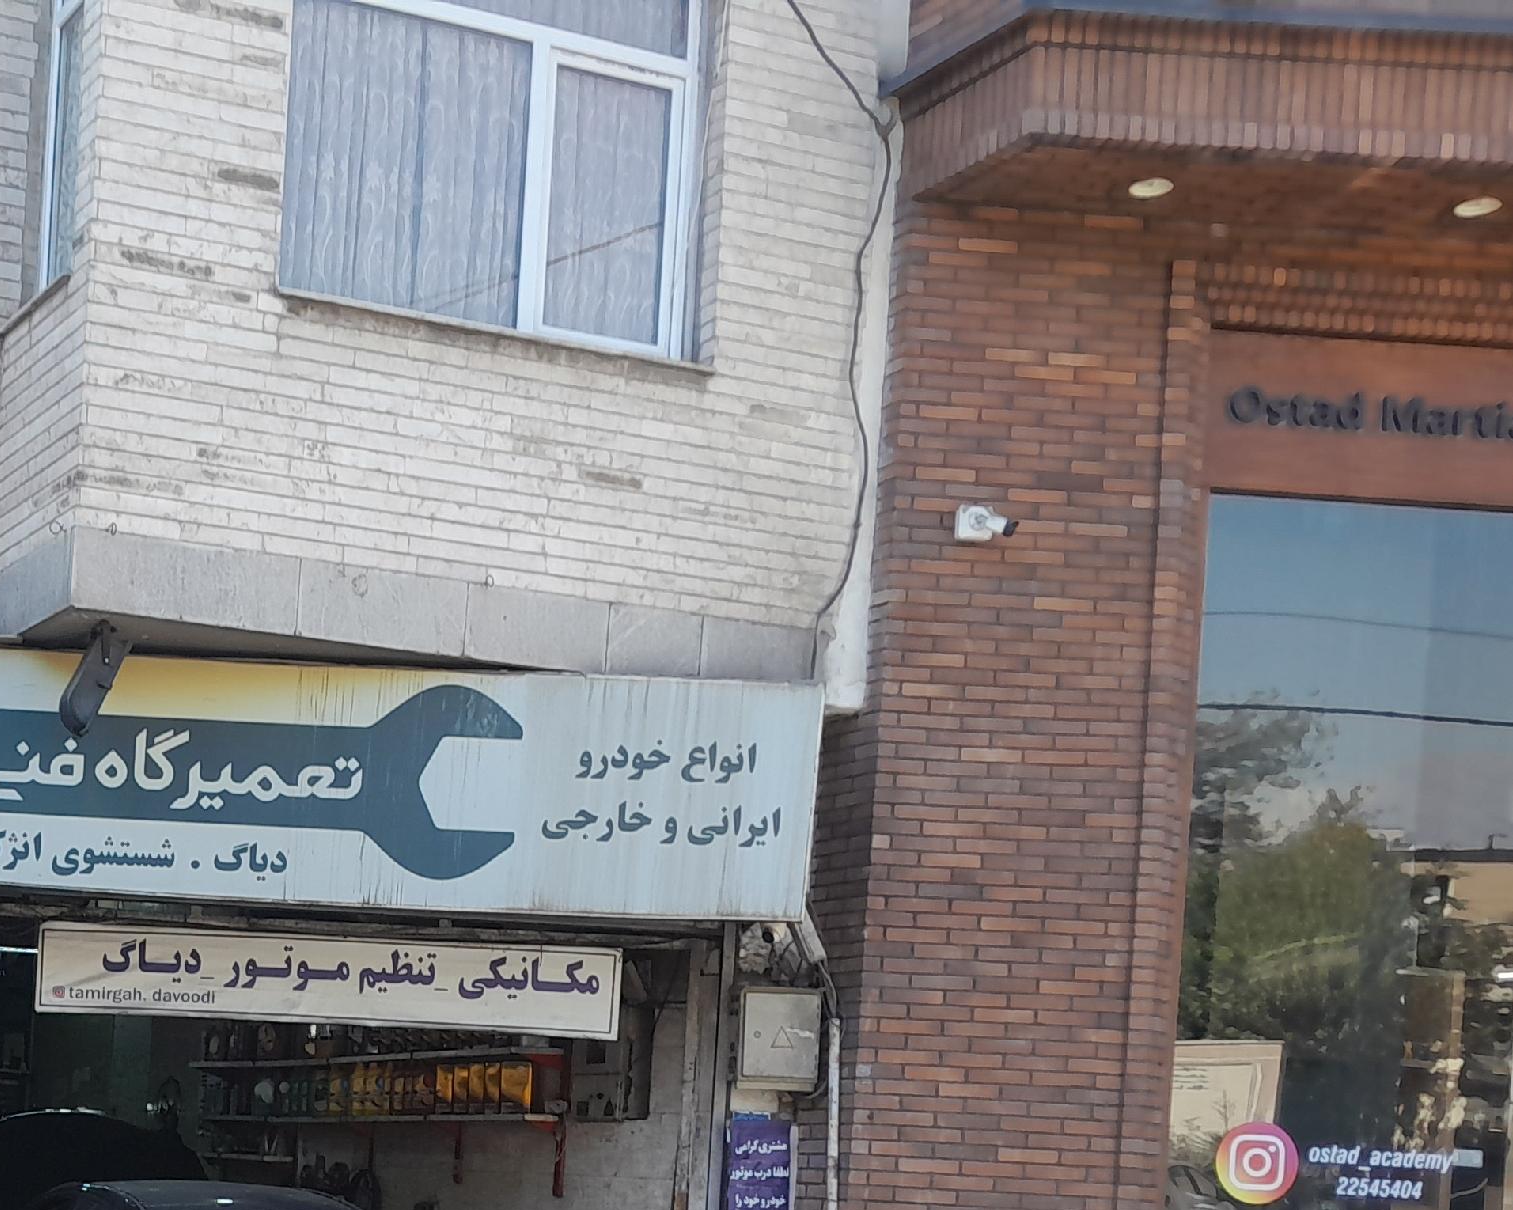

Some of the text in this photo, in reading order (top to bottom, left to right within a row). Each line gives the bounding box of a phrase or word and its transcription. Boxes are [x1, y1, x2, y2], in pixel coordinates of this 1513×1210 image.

[1230, 386, 1513, 441] Ostad Marti
[574, 740, 758, 784] انواع خودرو
[541, 799, 782, 848] ایرانی و خارجی
[50, 836, 176, 877] شستشوی
[213, 842, 288, 882] دیاگ
[223, 945, 350, 992] موتور
[458, 955, 600, 1000] مکانیکی
[1308, 1144, 1454, 1174] ostad_academy
[1336, 1175, 1424, 1200] 22545404
